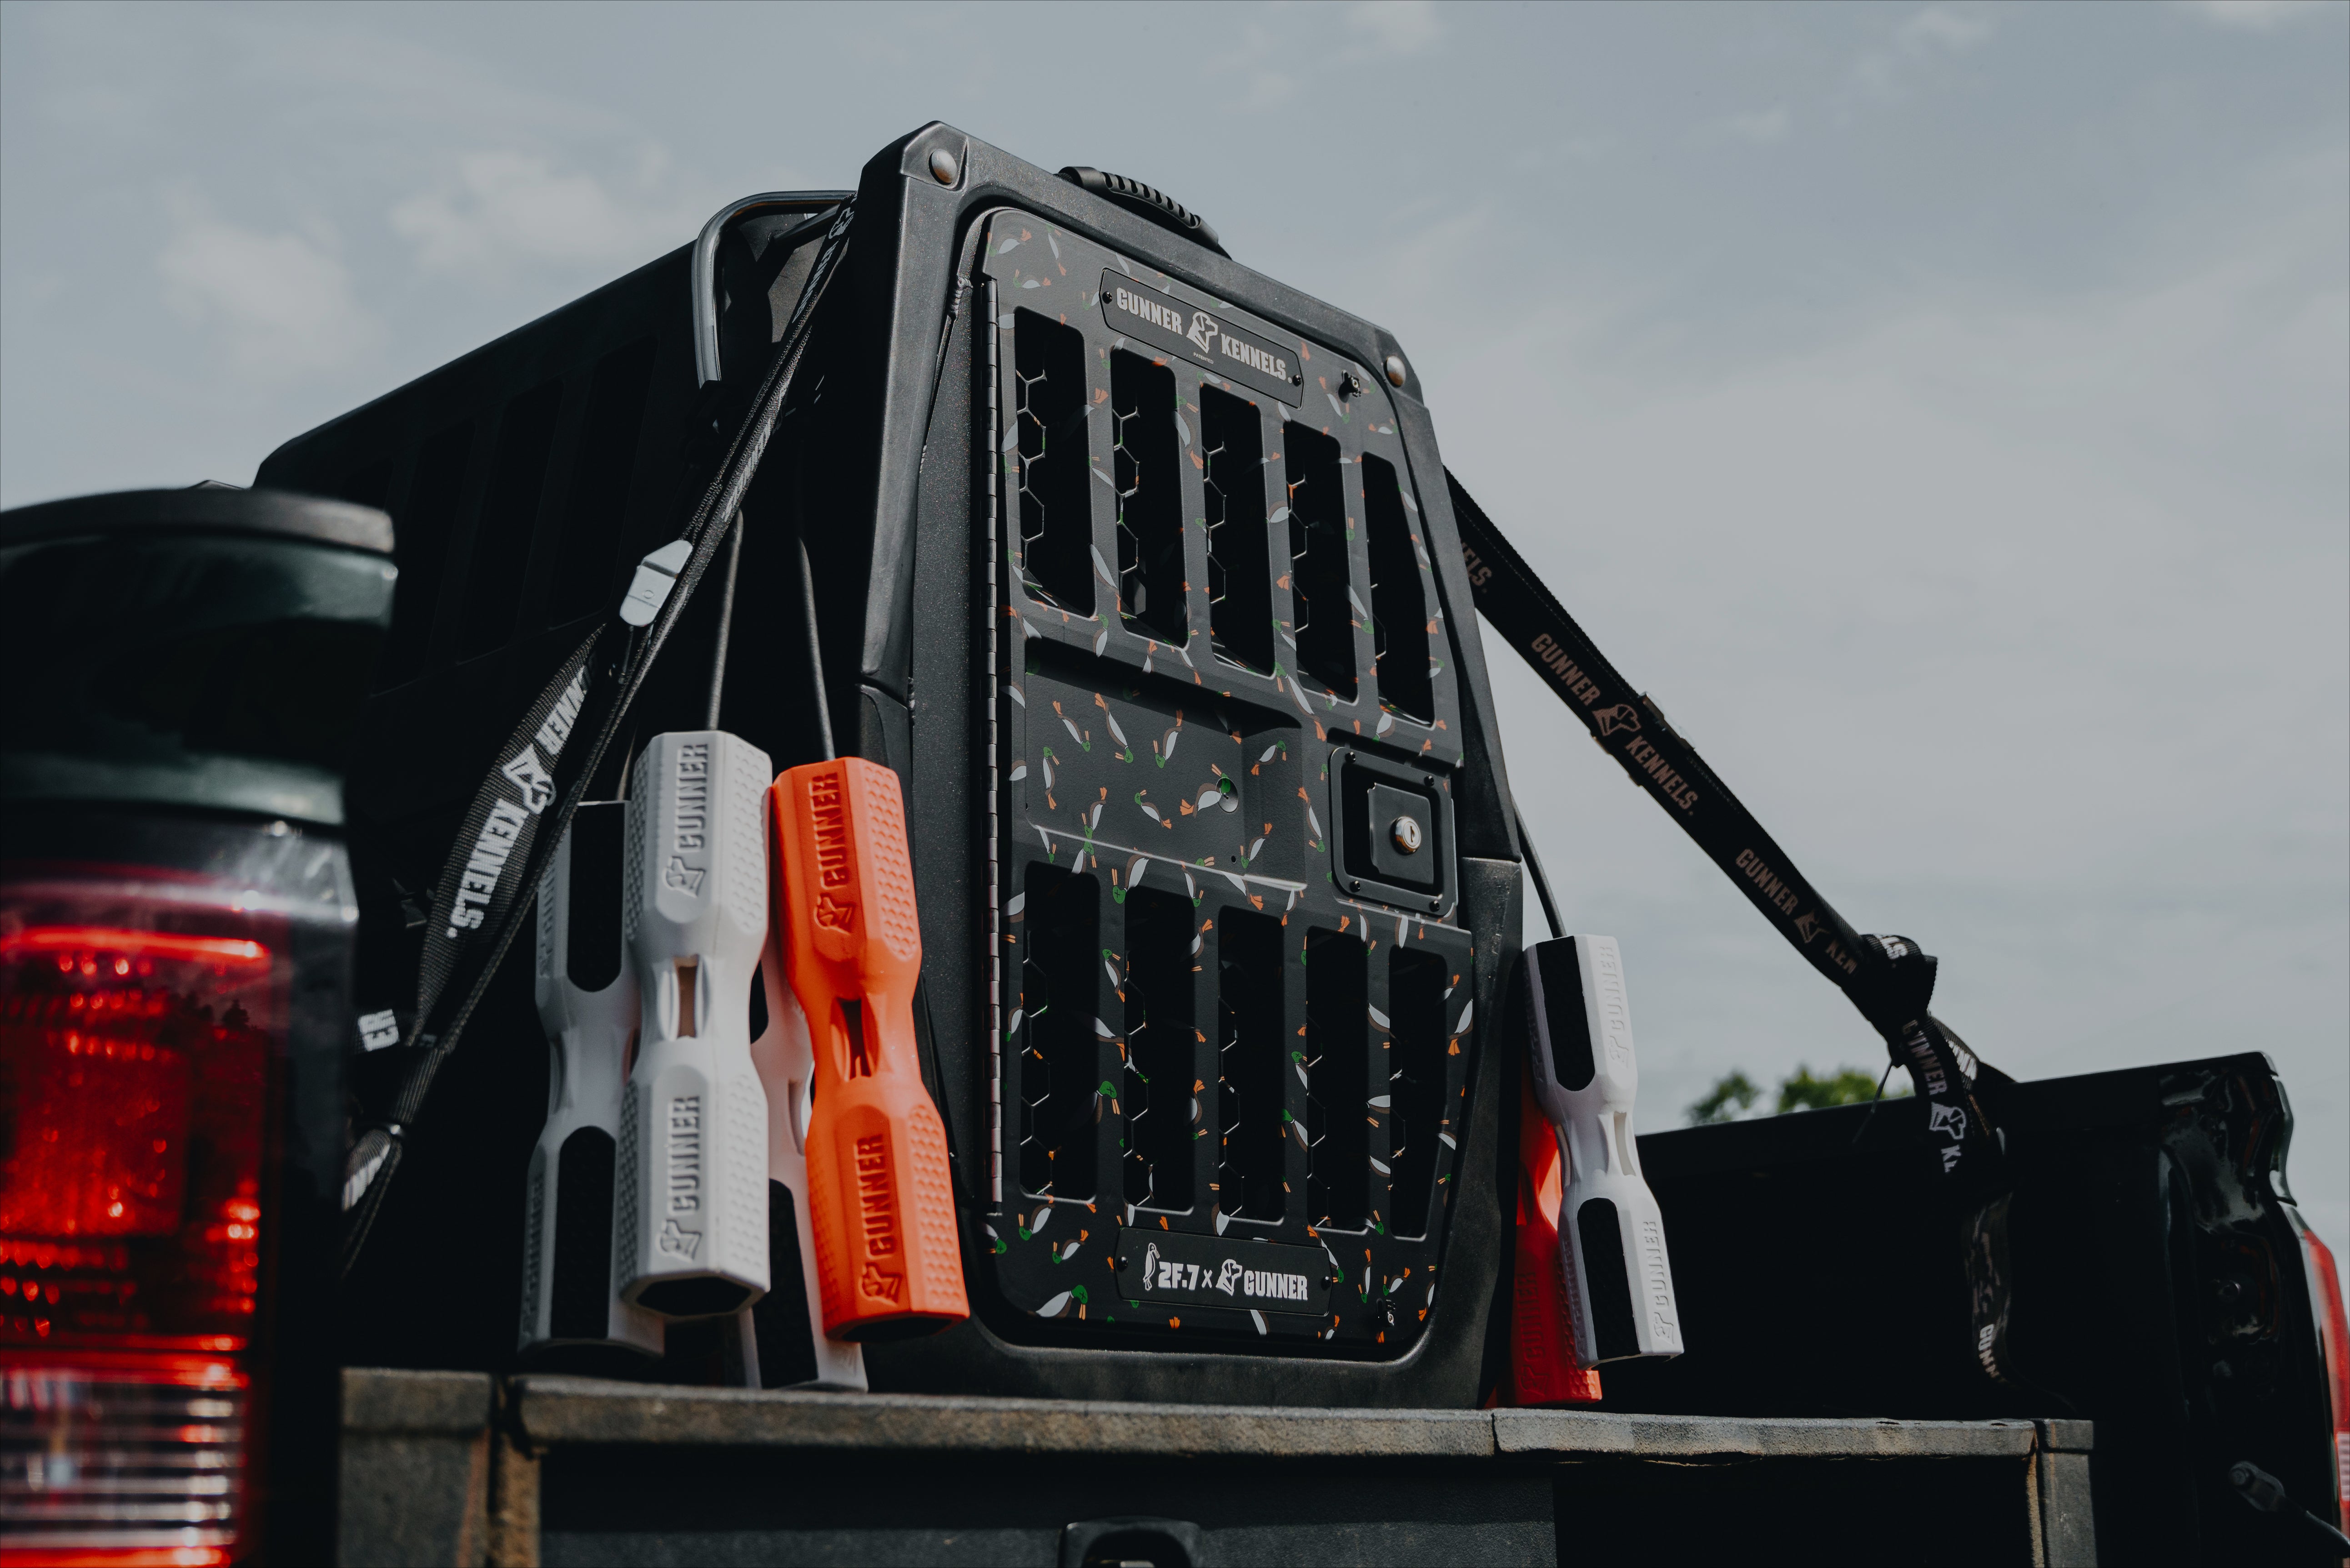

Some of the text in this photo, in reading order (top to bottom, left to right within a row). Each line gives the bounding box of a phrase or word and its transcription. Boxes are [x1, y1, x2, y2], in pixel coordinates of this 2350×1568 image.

[1116, 287, 1182, 335] GUNNER
[1193, 352, 1214, 364] PATENTED
[1531, 633, 1698, 810] GUNNER KENNELS
[674, 744, 708, 853] GUNNER
[808, 772, 849, 890] GUNNER
[1735, 848, 1798, 916] GUNNER
[1598, 946, 1625, 1032] GUNNER
[667, 1096, 700, 1216] GUNNER
[853, 1134, 896, 1260] GUNNER
[1158, 1261, 1200, 1291] 2F.7
[1244, 1270, 1308, 1301] GUNNER
[1642, 1221, 1669, 1308] GUNNER
[1516, 1272, 1546, 1361] GUNNER
